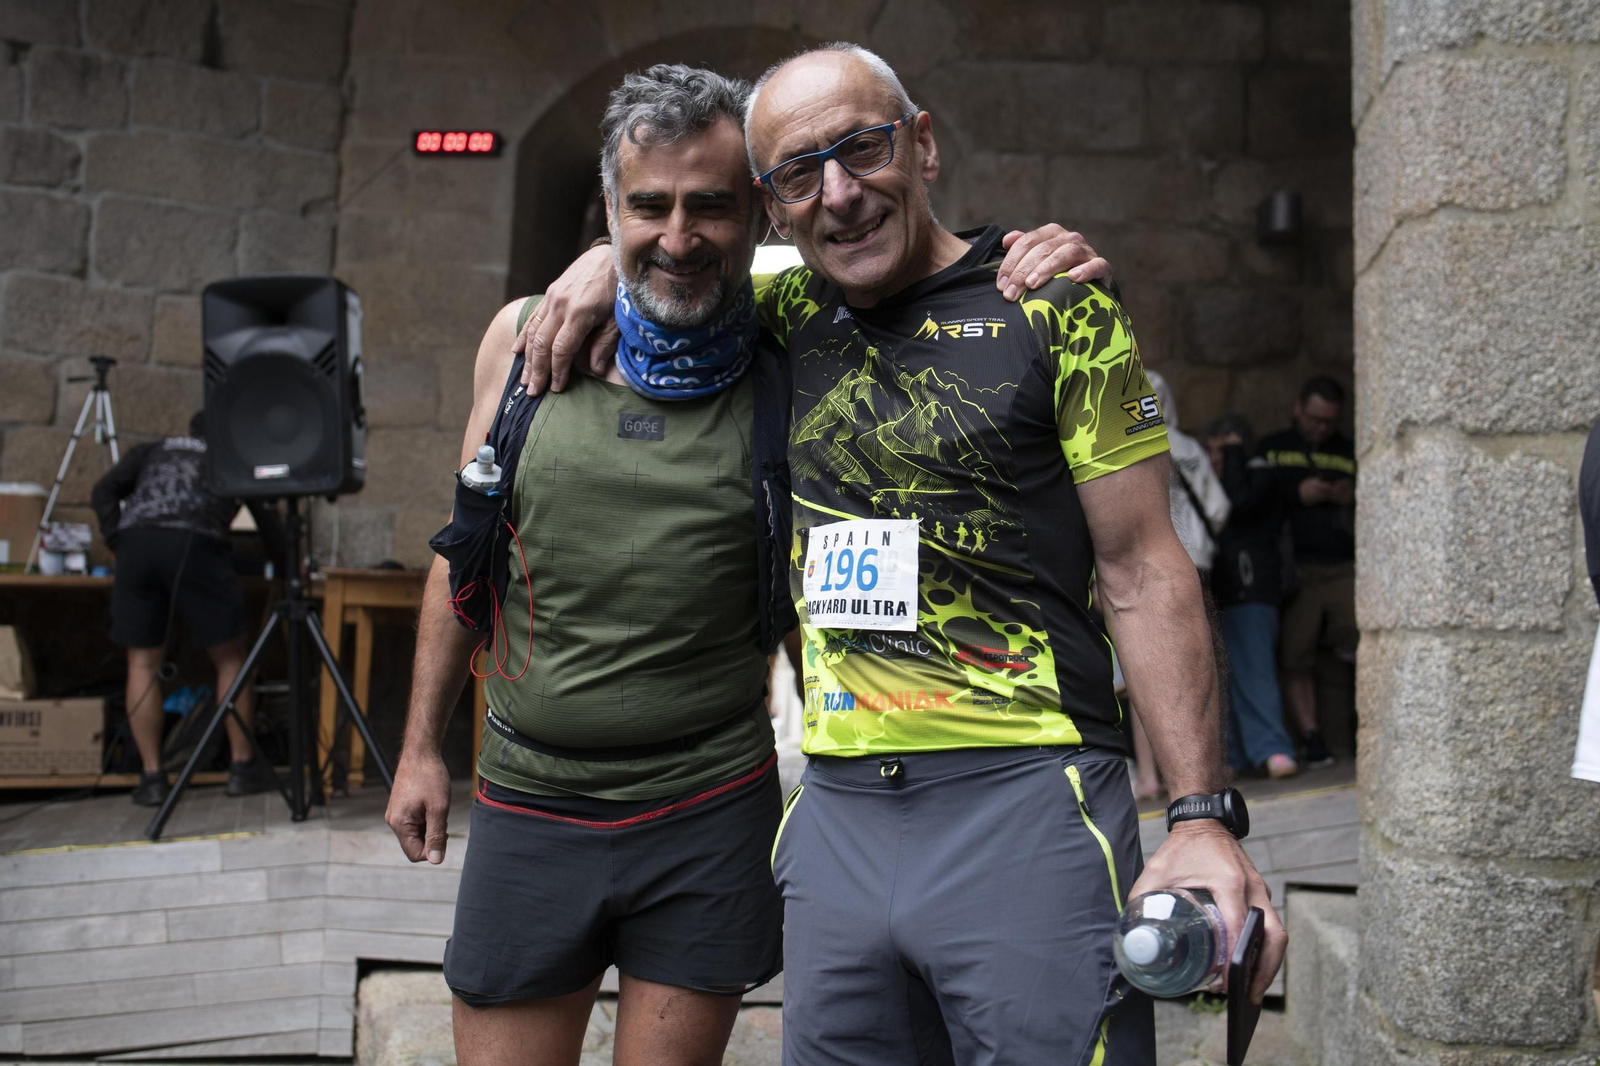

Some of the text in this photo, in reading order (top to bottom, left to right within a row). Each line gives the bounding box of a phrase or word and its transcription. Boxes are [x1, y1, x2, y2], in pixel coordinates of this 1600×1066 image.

[941, 322, 1006, 339] RST
[624, 420, 659, 433] GORE
[823, 530, 891, 550] SPAIN
[820, 548, 878, 592] 196
